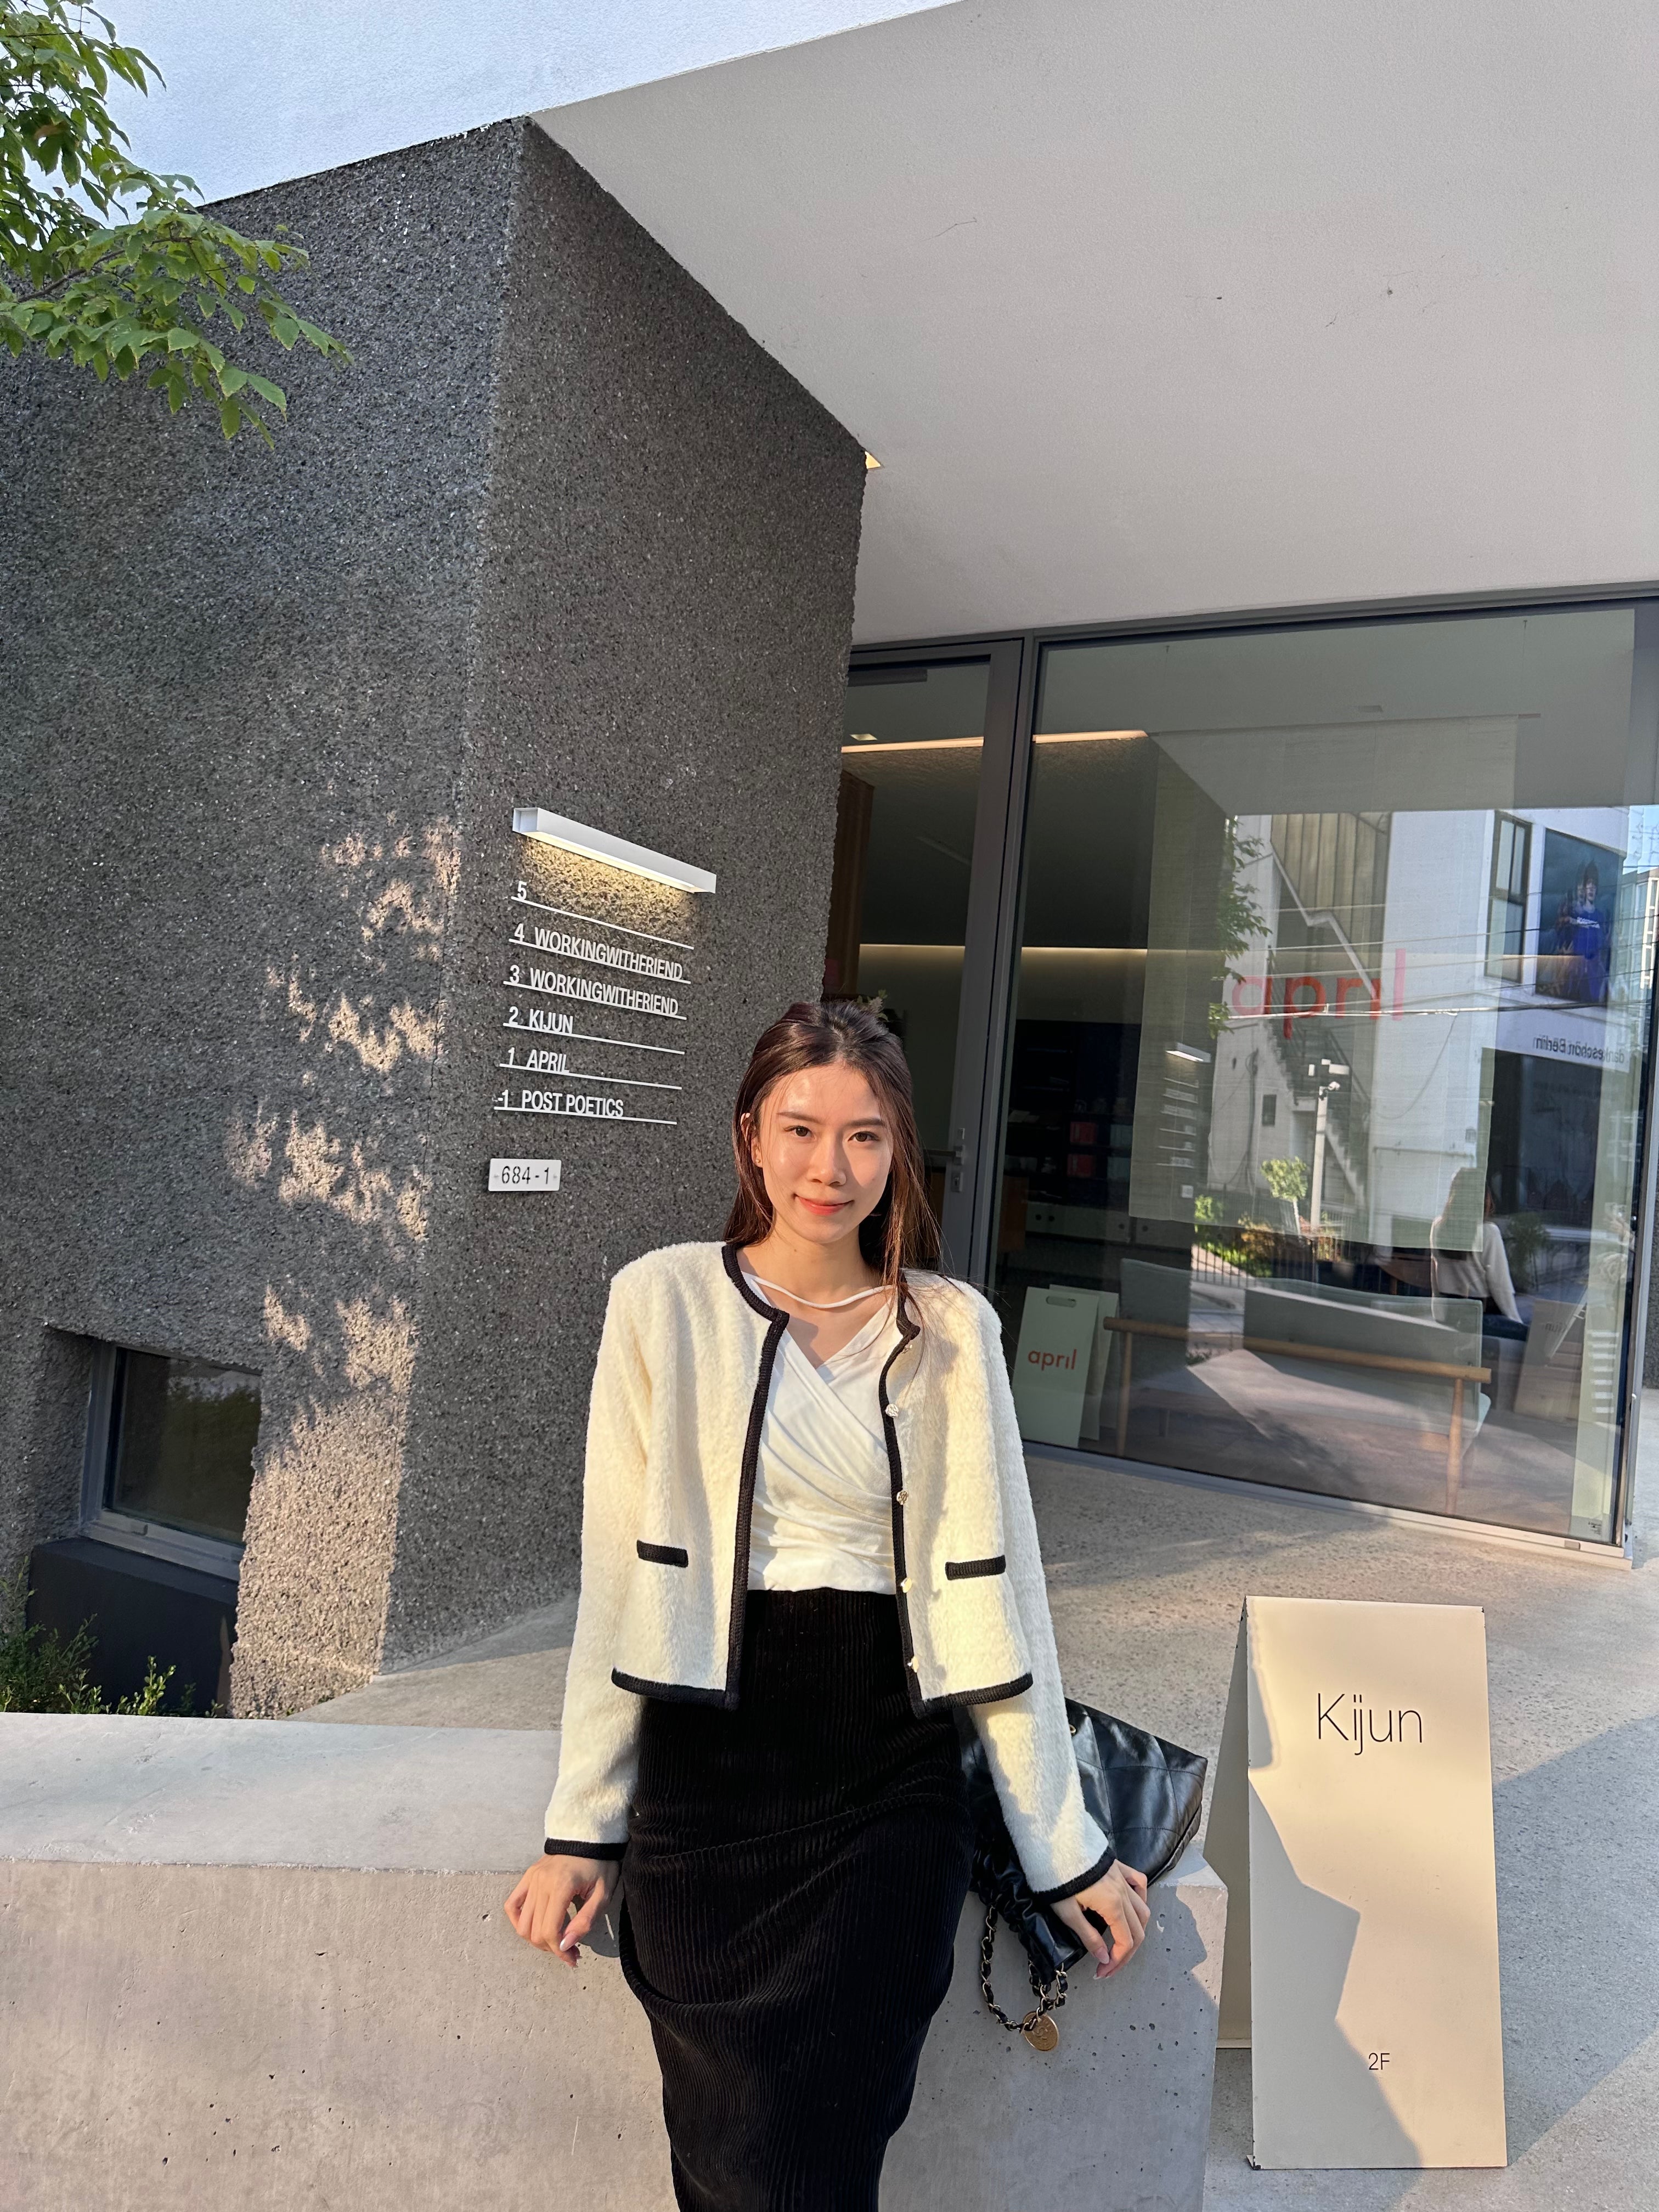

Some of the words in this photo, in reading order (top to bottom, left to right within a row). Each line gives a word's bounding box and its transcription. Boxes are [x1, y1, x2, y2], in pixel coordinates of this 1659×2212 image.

[517, 881, 527, 900] 5
[514, 923, 524, 943] 4
[535, 927, 683, 980] WORKINGWITHFRIEND
[509, 964, 520, 984] 3
[530, 967, 679, 1015] WORKINGWITHFRIEND
[1232, 948, 1406, 1040] april
[509, 1006, 519, 1025] 2
[529, 1009, 573, 1034] KIJUN
[508, 1047, 515, 1066] 1
[526, 1049, 569, 1073] APRIL
[498, 1090, 509, 1108] -1
[522, 1090, 563, 1112] POST
[566, 1094, 624, 1118] POETICS
[1028, 1348, 1077, 1371] april
[1318, 1693, 1423, 1756] Kijun
[1368, 2052, 1390, 2070] 2F
